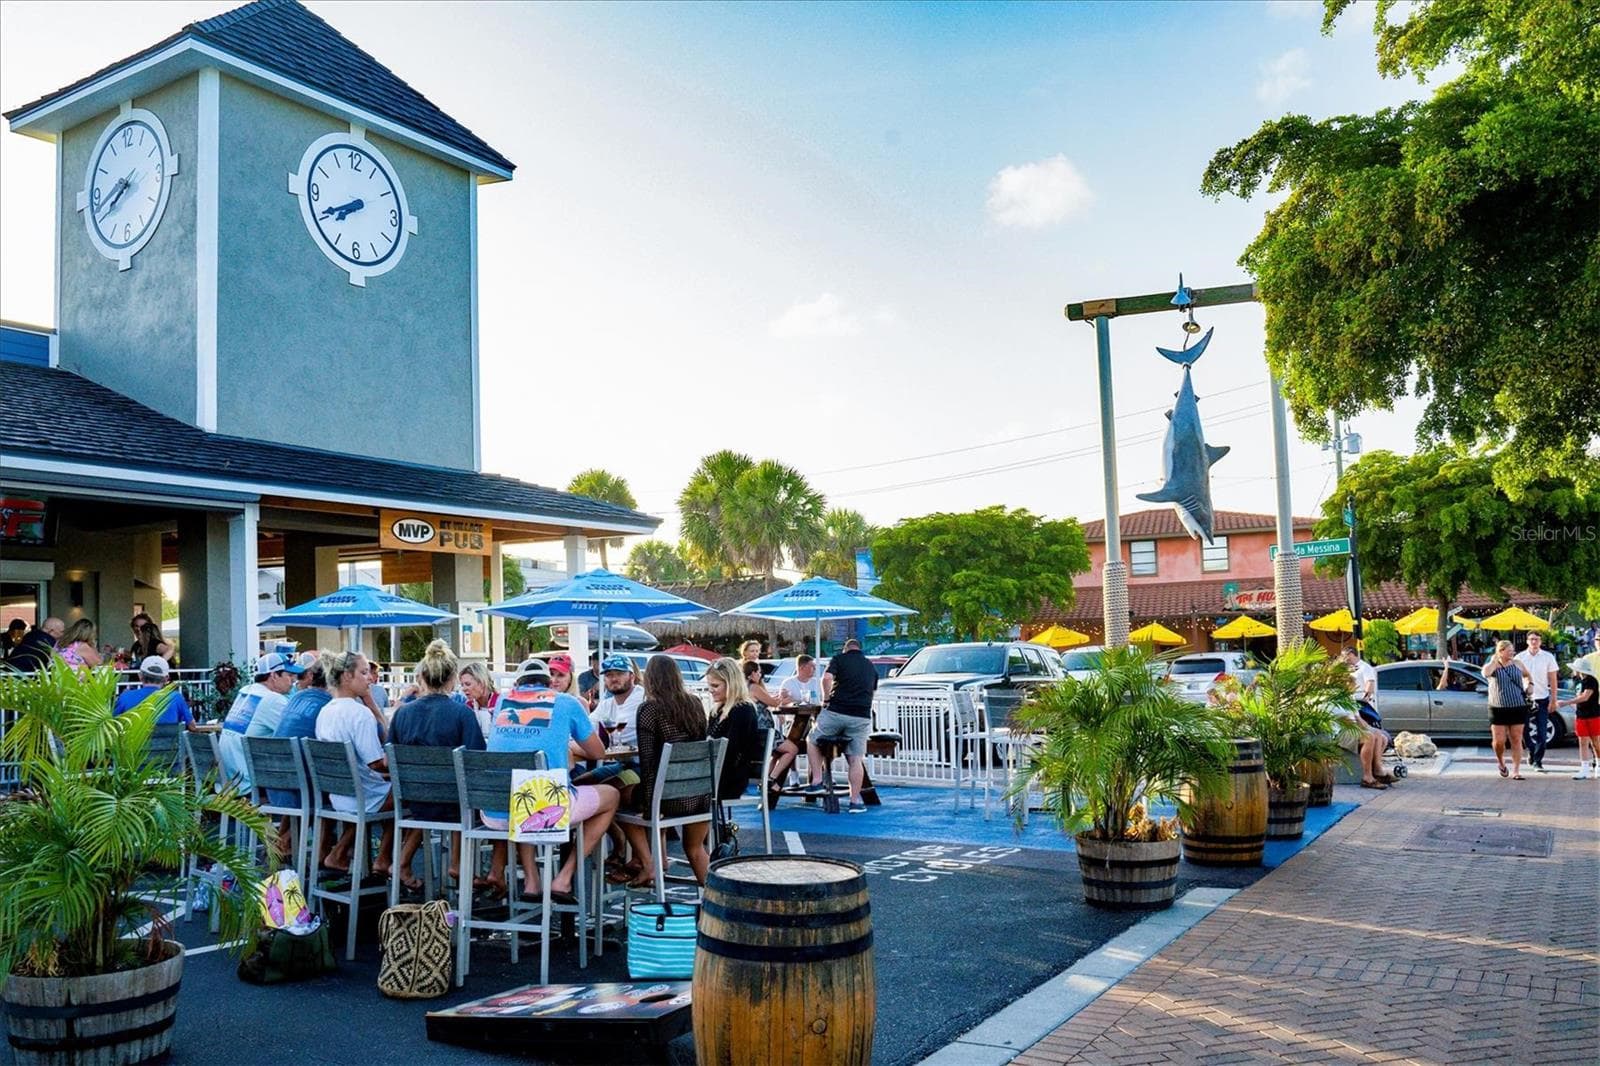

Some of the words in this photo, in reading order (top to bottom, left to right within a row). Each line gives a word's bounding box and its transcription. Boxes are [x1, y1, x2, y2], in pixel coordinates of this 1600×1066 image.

[122, 127, 133, 148] 12
[348, 151, 362, 173] 12
[94, 187, 101, 206] 9
[311, 183, 320, 202] 9
[389, 209, 398, 228] 3
[123, 223, 131, 242] 6
[351, 241, 361, 260] 6
[398, 522, 431, 539] MVP
[439, 531, 485, 550] PUB
[1307, 543, 1340, 555] Messina
[496, 727, 521, 735] LOCAL
[524, 727, 542, 736] BOY
[890, 846, 1022, 883] CYCLES
